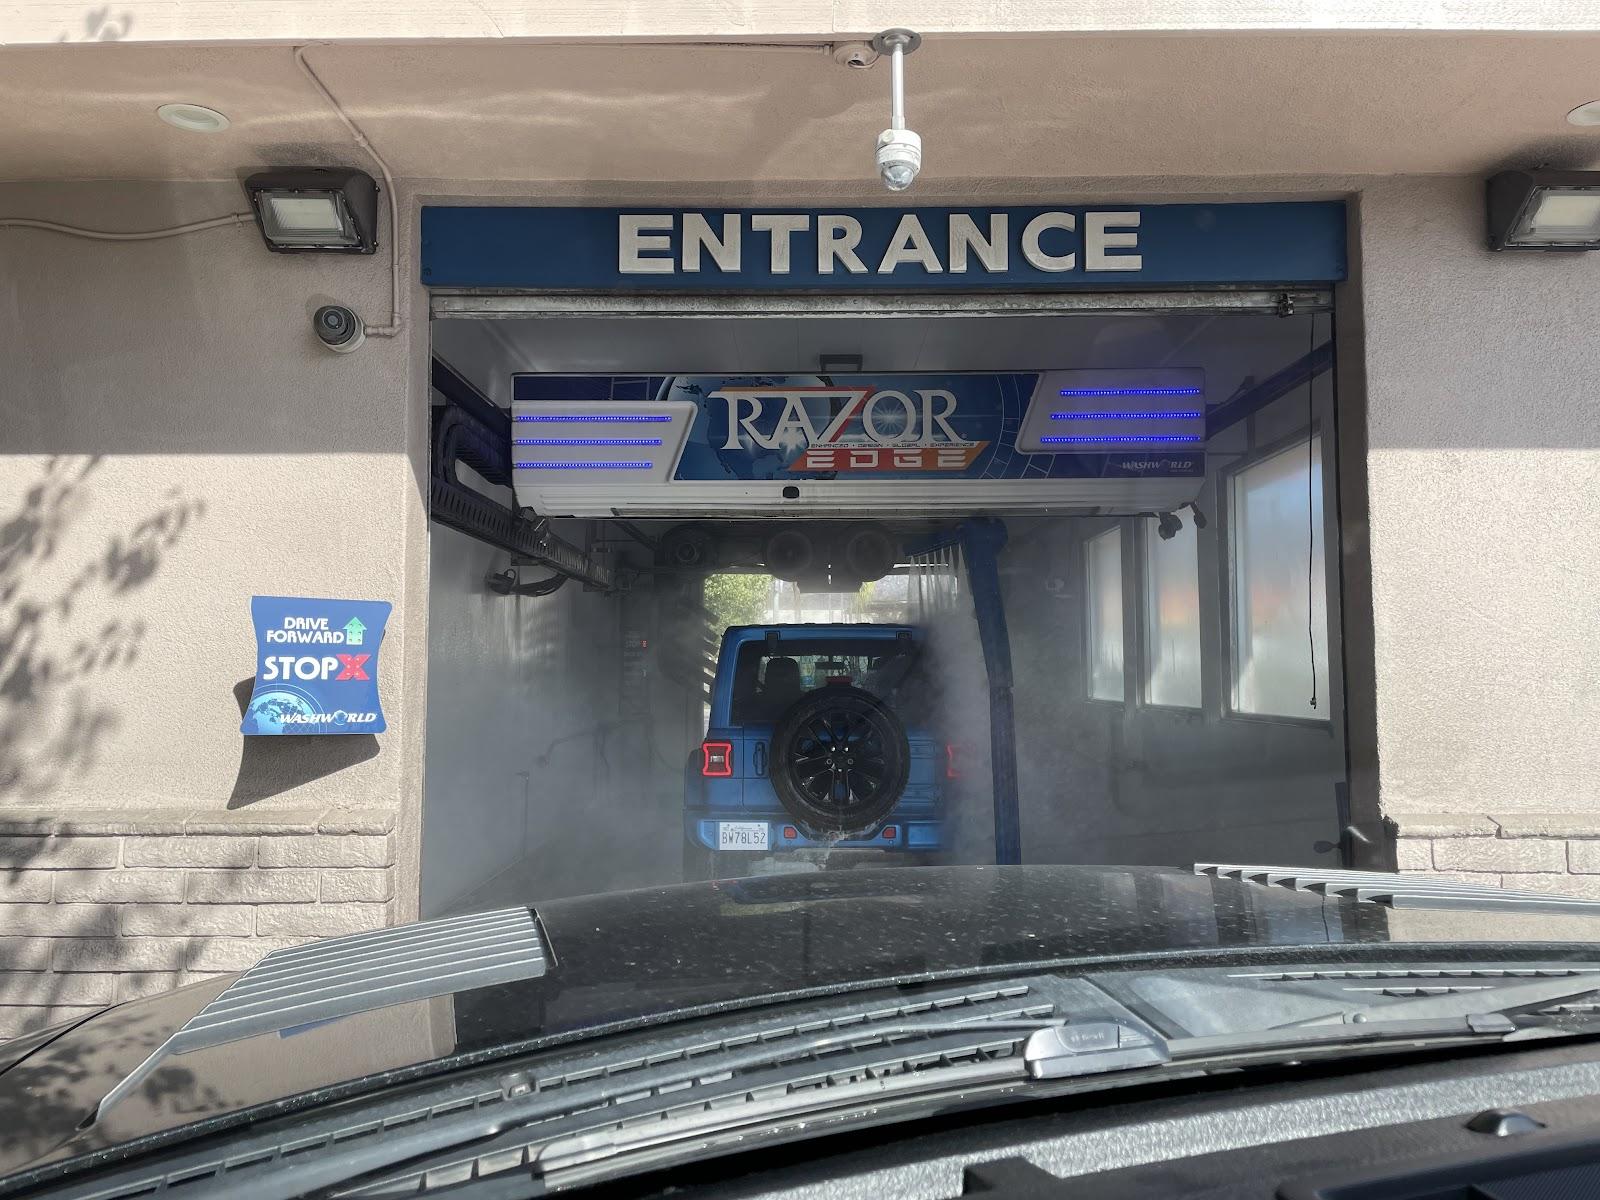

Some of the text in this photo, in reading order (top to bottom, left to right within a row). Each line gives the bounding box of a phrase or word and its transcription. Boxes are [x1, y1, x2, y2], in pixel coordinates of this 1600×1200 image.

[618, 211, 1143, 275] ENTRANCE
[707, 389, 968, 450] RAZOR
[806, 449, 966, 468] EDGE
[284, 617, 328, 630] DRIVE
[266, 630, 344, 644] FORWARD
[263, 656, 338, 680] STOP
